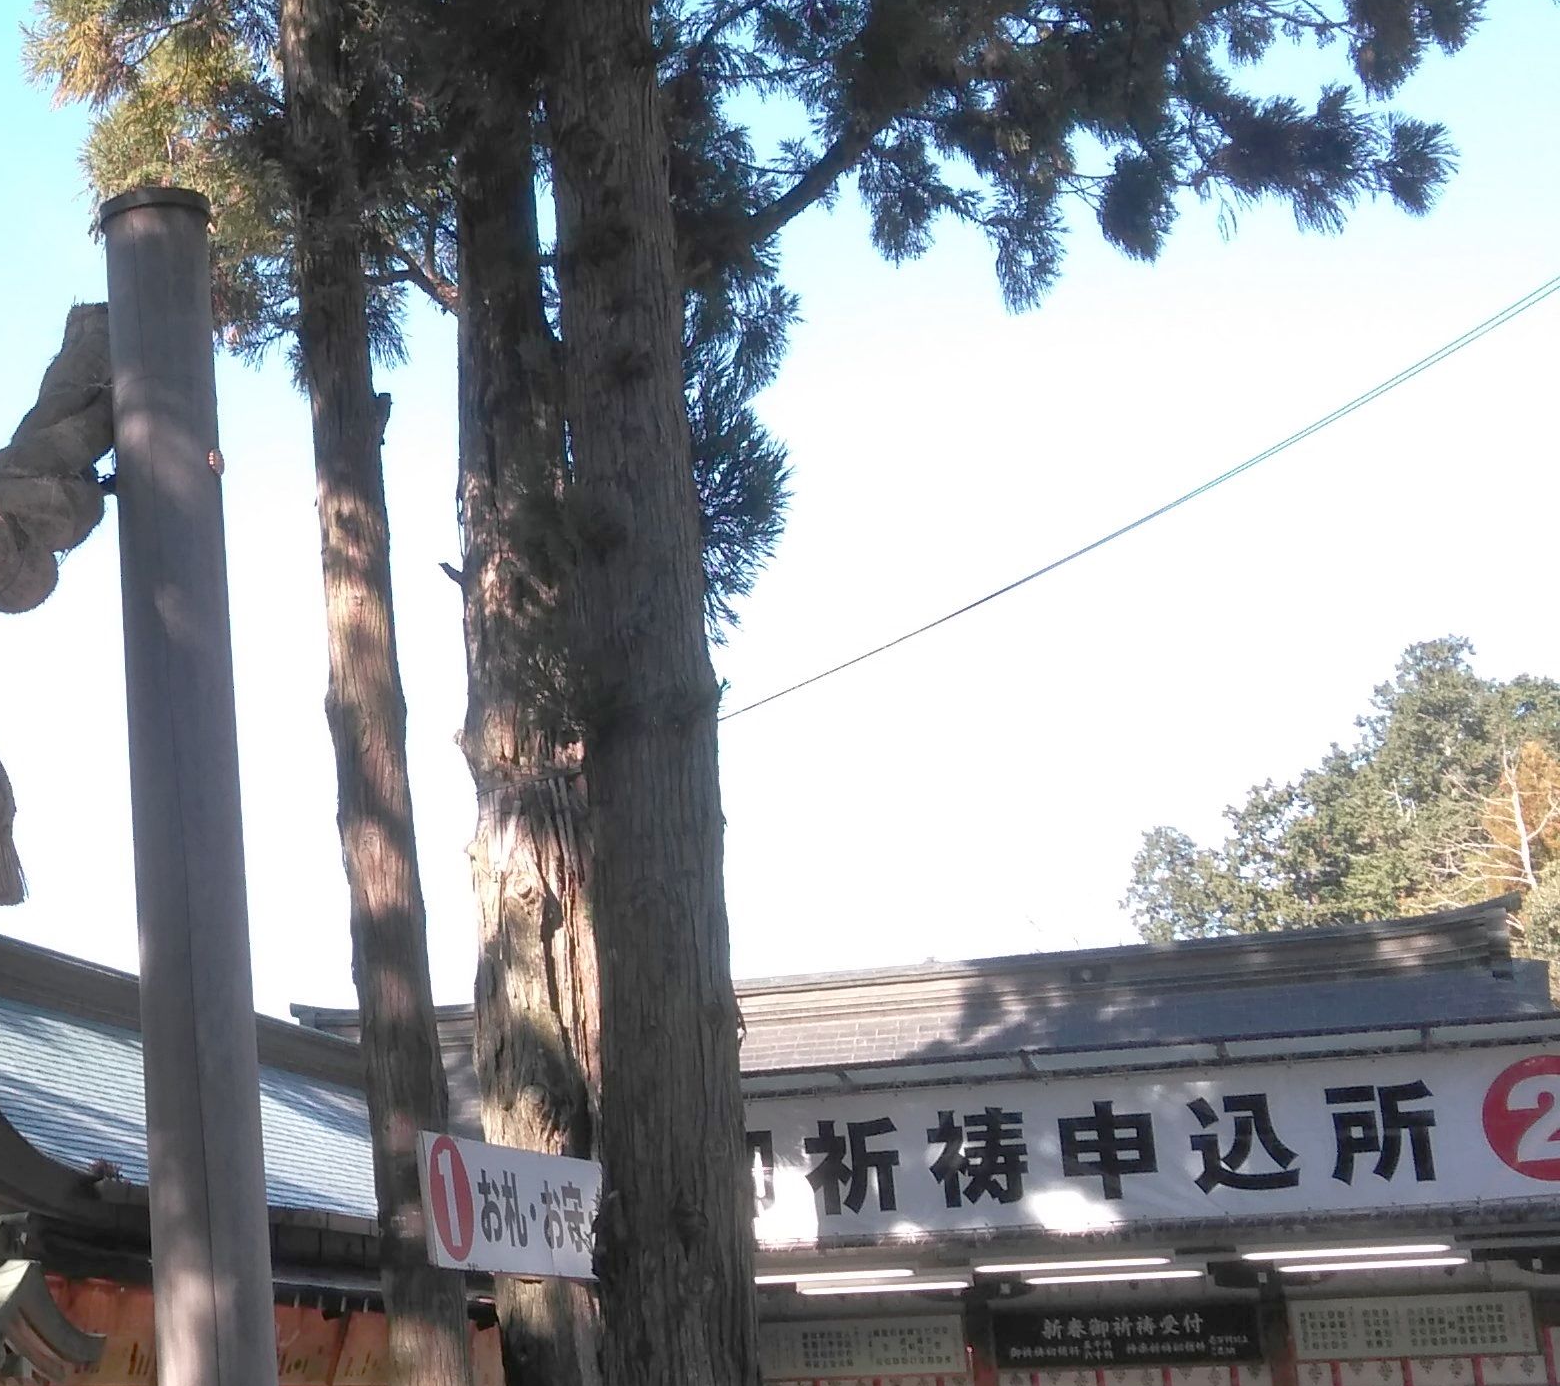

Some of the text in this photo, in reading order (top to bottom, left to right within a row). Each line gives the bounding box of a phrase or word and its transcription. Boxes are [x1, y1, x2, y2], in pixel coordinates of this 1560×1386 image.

[745, 1079, 1437, 1216] 祈祷申込所
[476, 1167, 596, 1254] お札・お守
